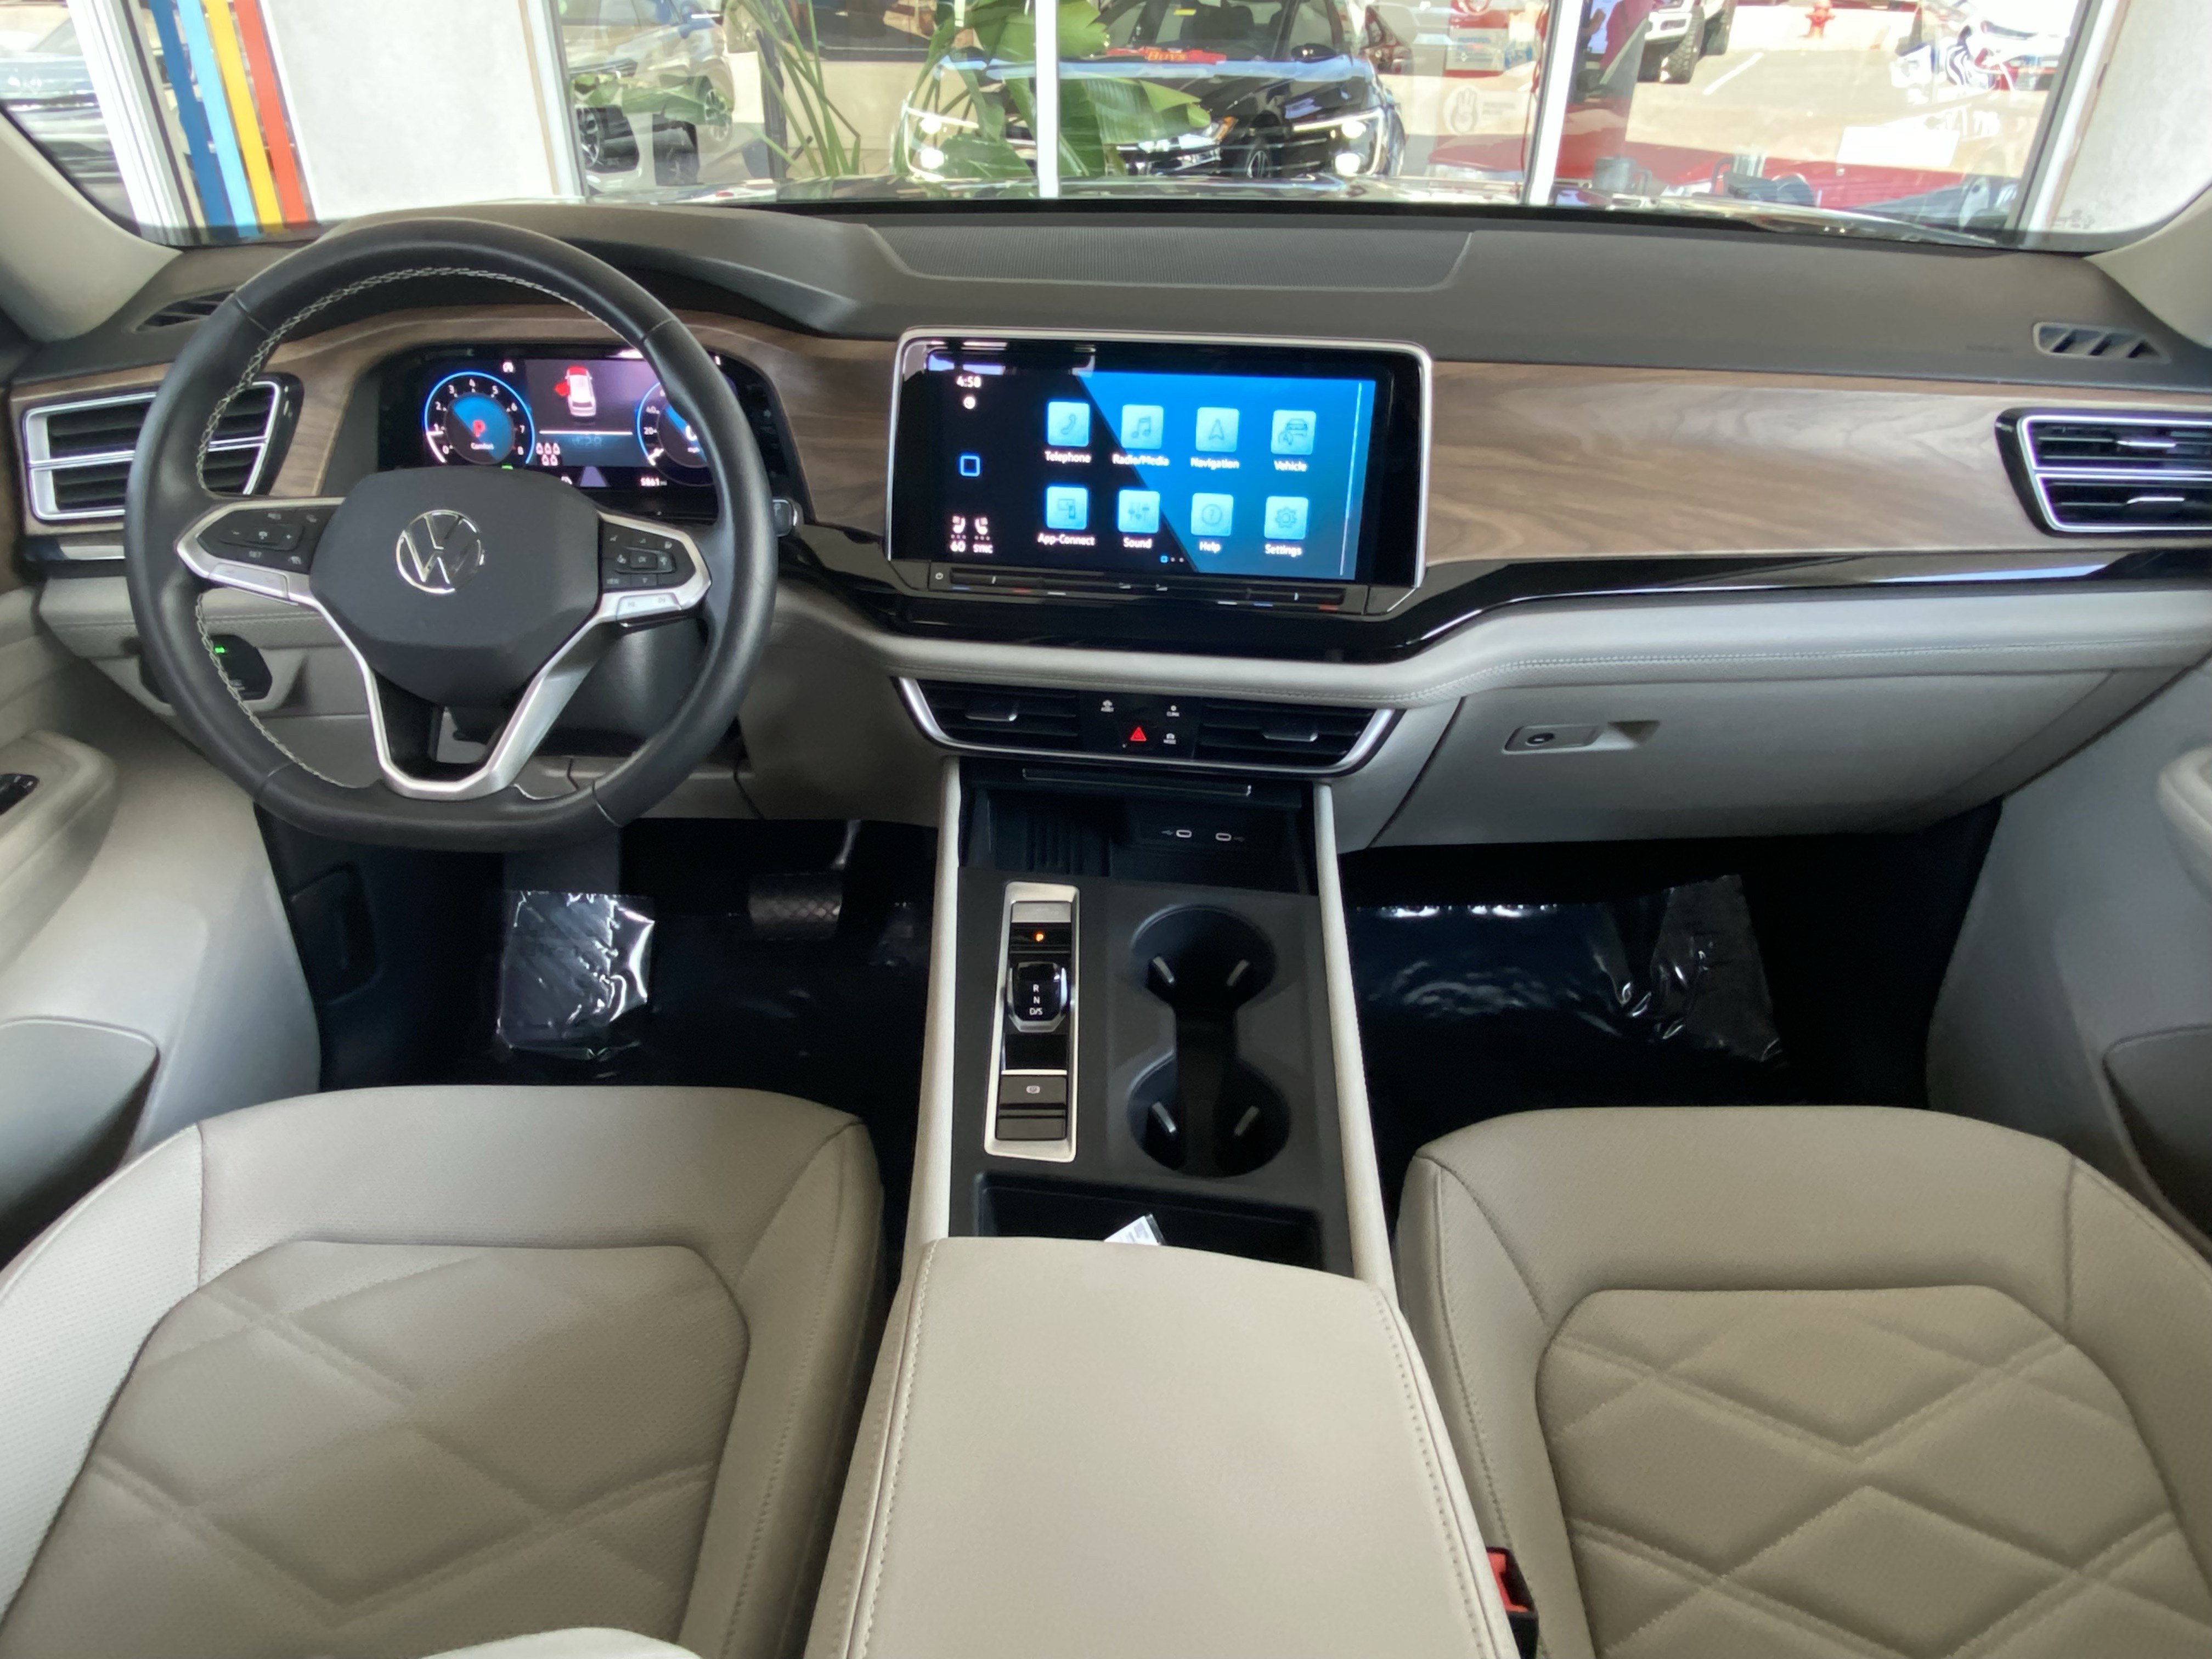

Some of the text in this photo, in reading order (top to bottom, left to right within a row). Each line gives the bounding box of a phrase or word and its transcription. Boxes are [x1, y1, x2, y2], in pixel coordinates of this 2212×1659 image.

[448, 385, 455, 394] 3
[492, 385, 499, 394] 5
[435, 401, 441, 410] 2
[511, 403, 517, 411] 6
[472, 419, 486, 438] P
[520, 425, 525, 434] 7
[442, 445, 449, 455] 0
[517, 446, 524, 455] 8
[1045, 451, 1091, 464] Telephone
[1113, 454, 1170, 466] Radio/Media
[1190, 458, 1239, 470] Navigation
[1274, 460, 1307, 472] Vehicle
[1038, 533, 1096, 546] App-Connect
[1124, 537, 1152, 548] Sound
[951, 540, 966, 552] 60
[973, 544, 993, 554] SYNC
[1199, 541, 1221, 553] Help
[1265, 544, 1302, 557] Settings
[1033, 984, 1040, 992] R
[1029, 1007, 1043, 1015] D/S
